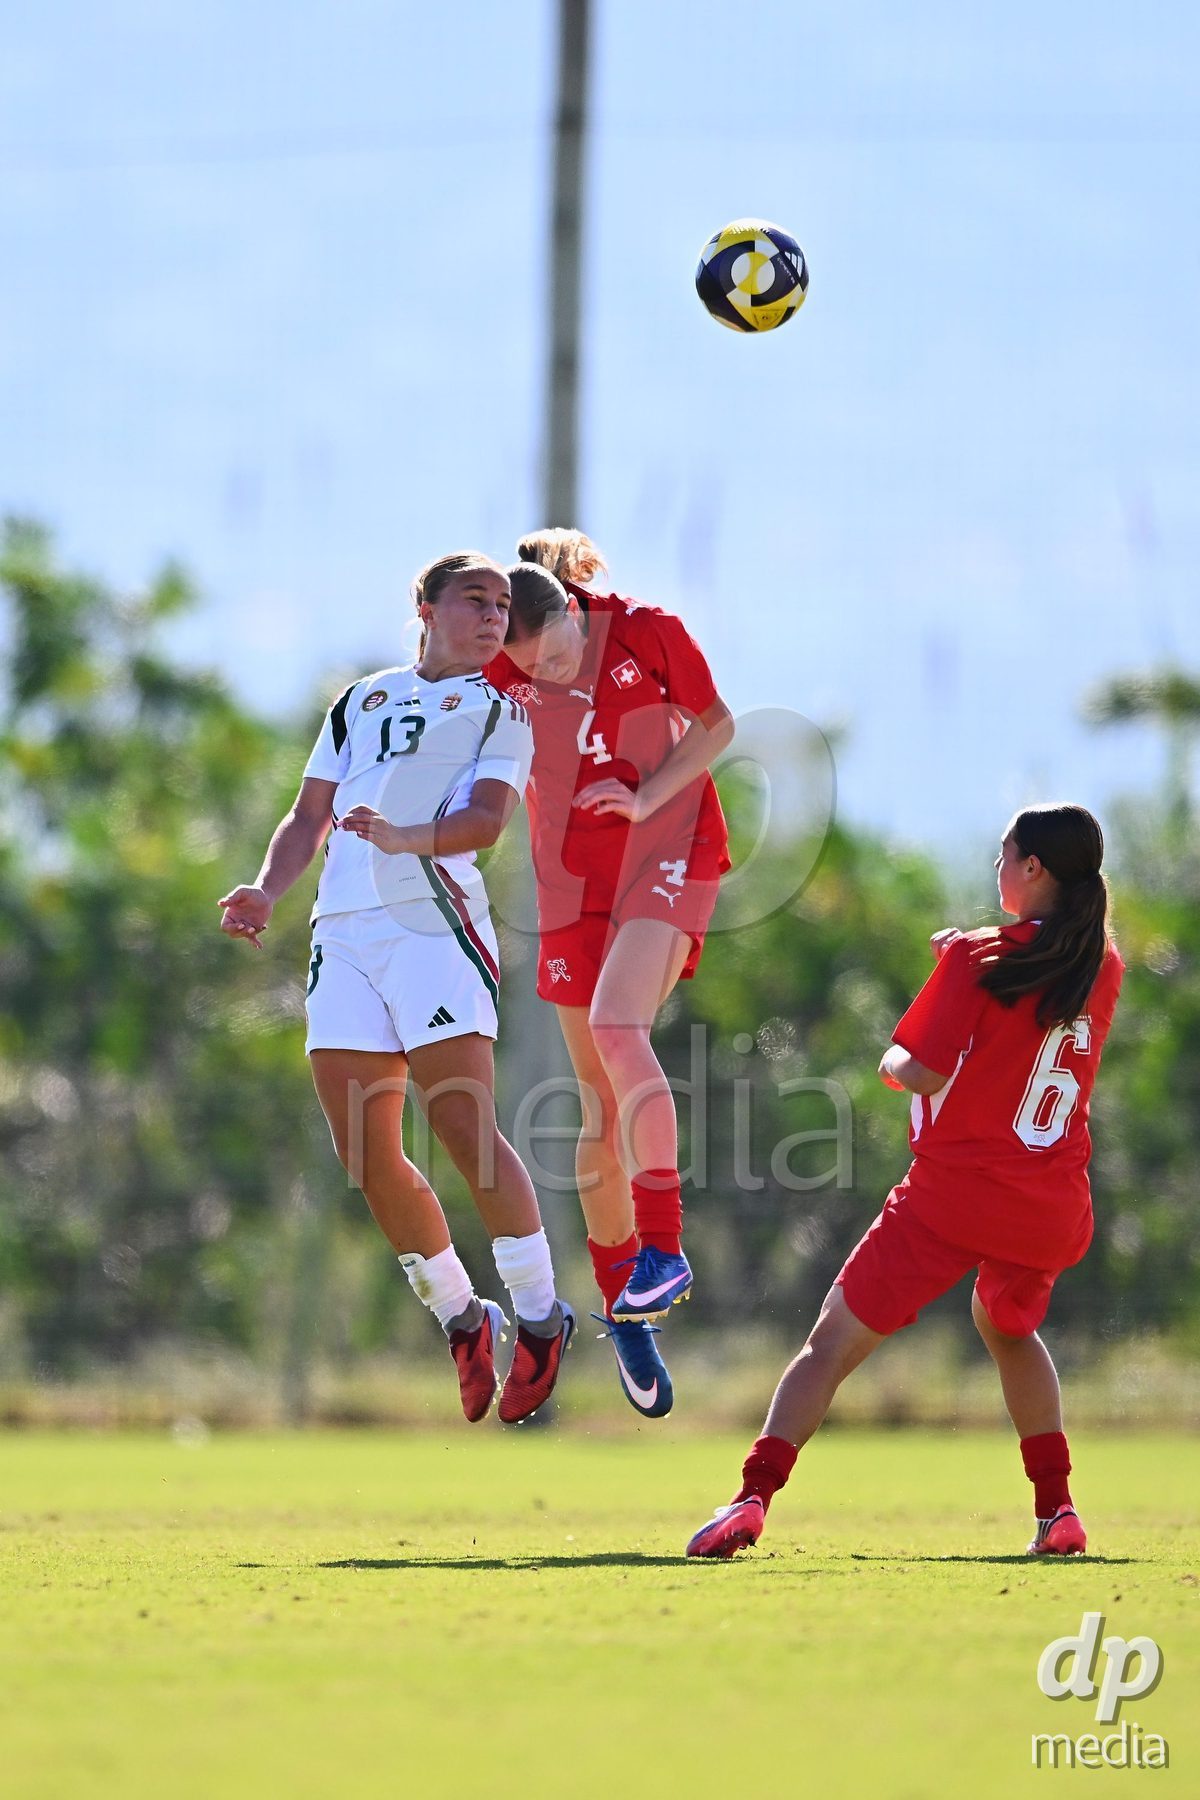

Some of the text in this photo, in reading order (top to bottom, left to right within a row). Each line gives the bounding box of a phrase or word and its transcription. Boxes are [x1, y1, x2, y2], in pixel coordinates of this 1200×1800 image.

[376, 715, 426, 763] 13
[576, 709, 613, 765] 4
[1012, 1015, 1092, 1152] 6
